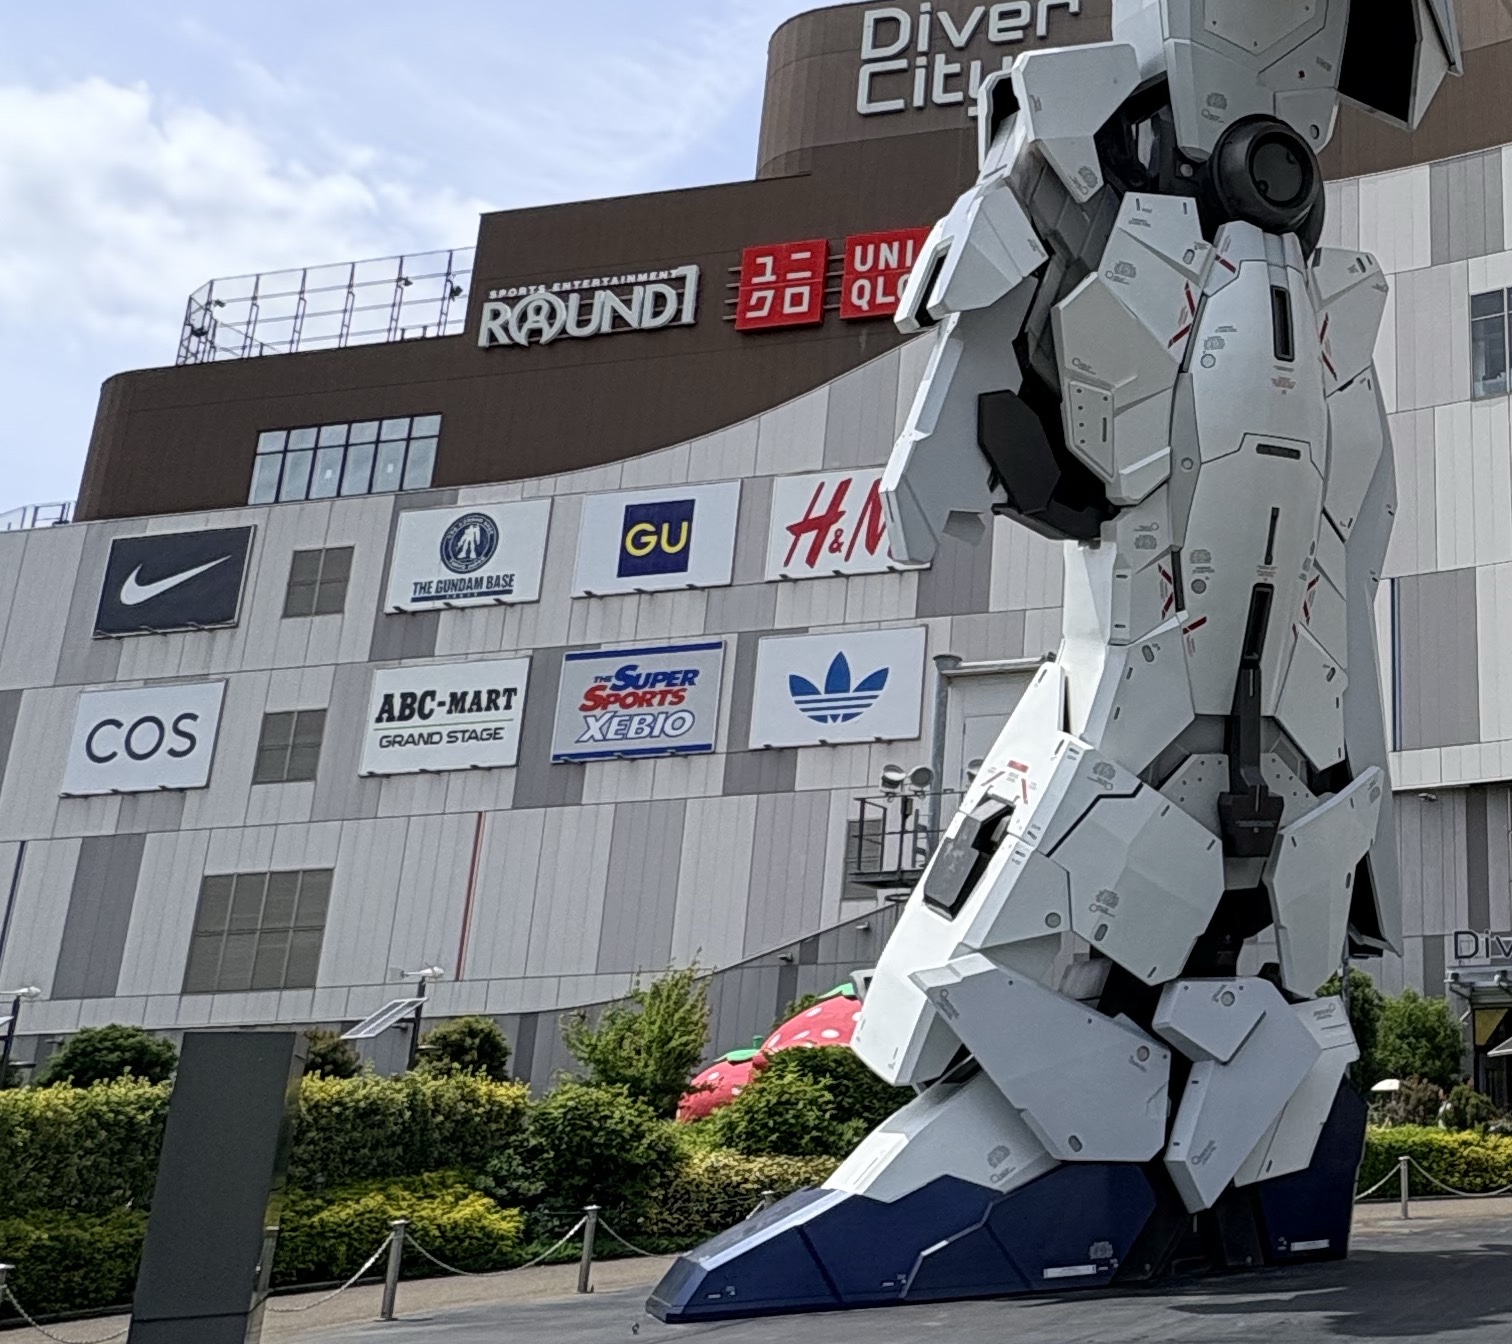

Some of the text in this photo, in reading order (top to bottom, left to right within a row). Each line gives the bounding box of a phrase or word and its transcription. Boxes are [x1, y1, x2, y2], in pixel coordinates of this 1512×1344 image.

[854, 240, 914, 272] UNI
[488, 269, 679, 299] SPORTS ENTERTAINMENT
[625, 521, 688, 556] GU
[413, 573, 515, 595] THE GUNDAM BASE
[594, 664, 700, 691] THE SUPER
[375, 687, 517, 723] ABC-MART
[578, 685, 688, 712] SPORTS
[86, 712, 199, 763] COS
[379, 727, 505, 749] GRAND STAGE
[575, 709, 695, 744] XEBIO
